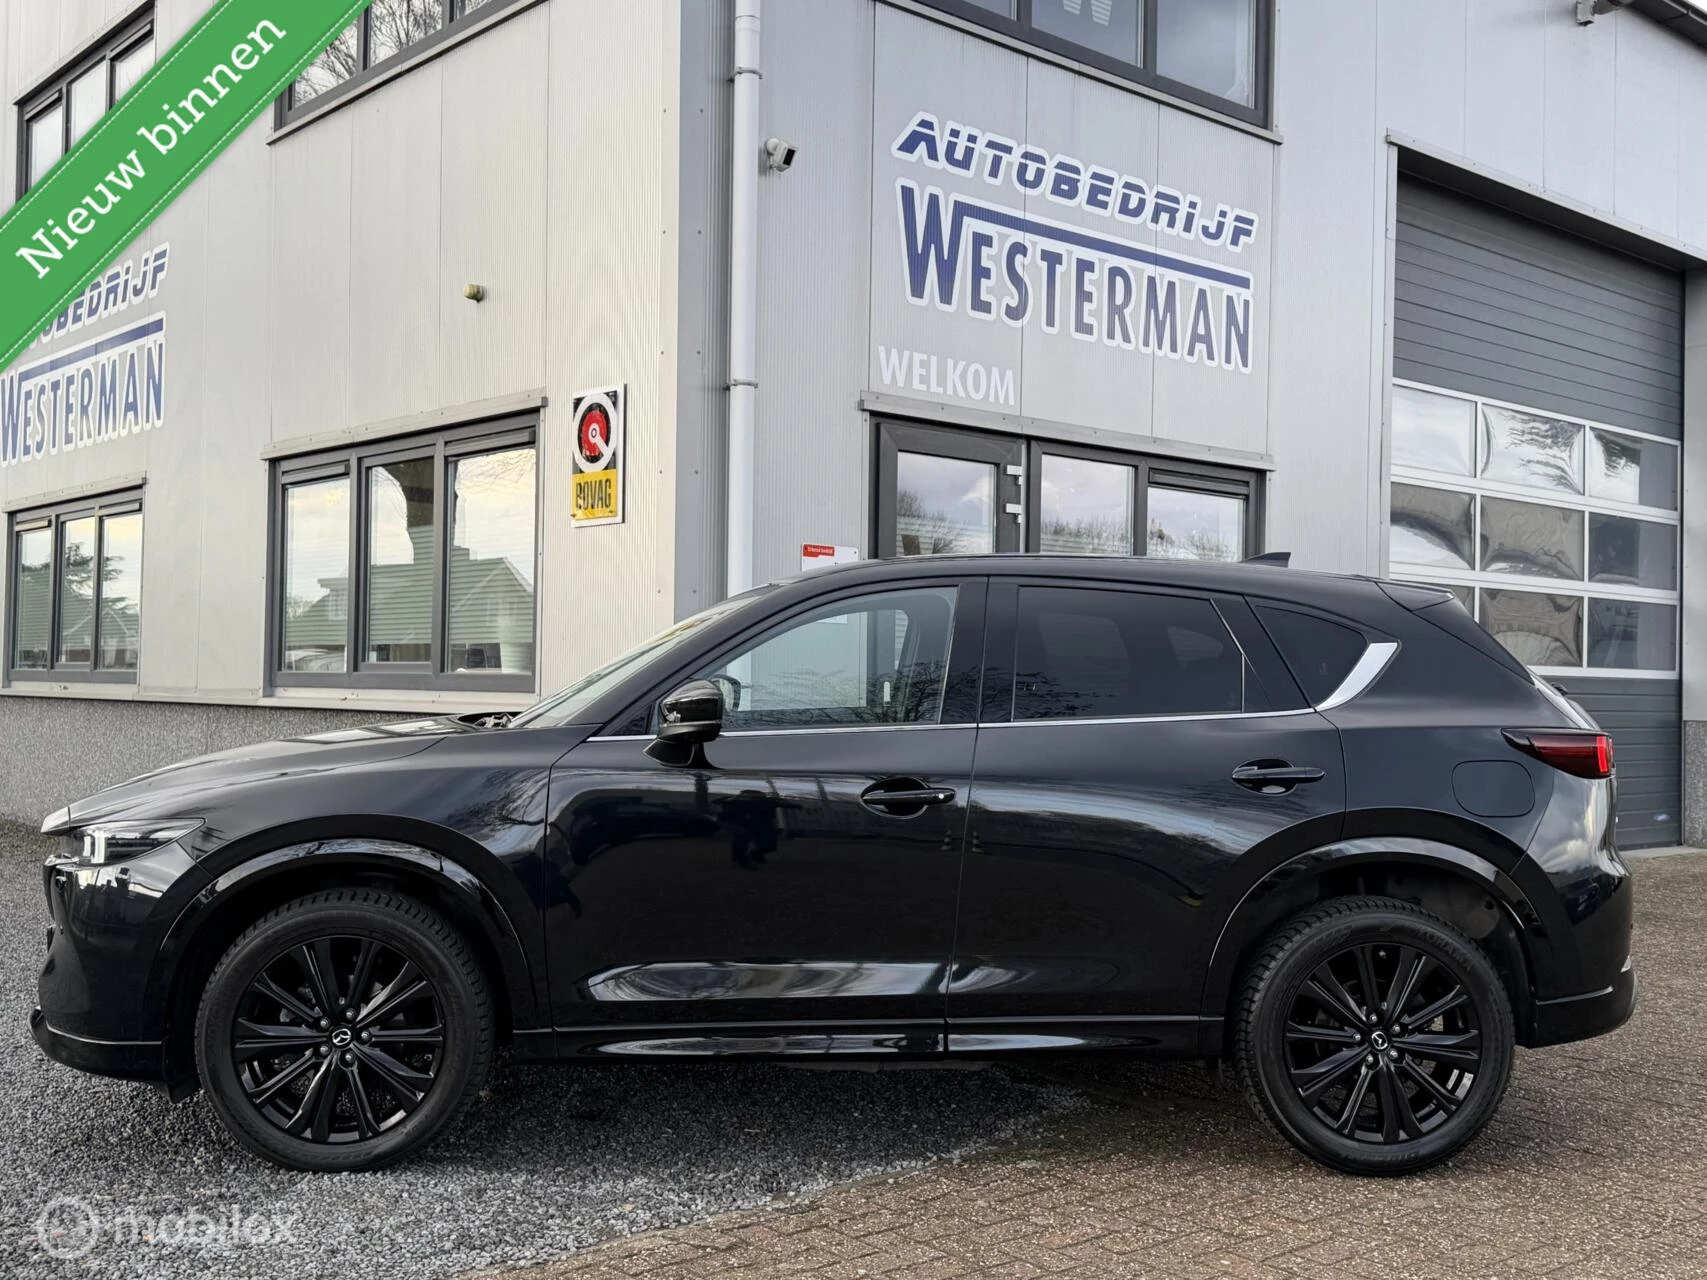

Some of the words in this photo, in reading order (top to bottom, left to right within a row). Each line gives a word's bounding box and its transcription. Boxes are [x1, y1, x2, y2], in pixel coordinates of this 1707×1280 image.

[896, 118, 1256, 247] AUTOBEDRIJF
[900, 184, 1251, 369] WESTERMAN
[0, 338, 164, 462] WESTERMAN
[877, 346, 1015, 406] WELKOM
[575, 478, 612, 511] BOVAG
